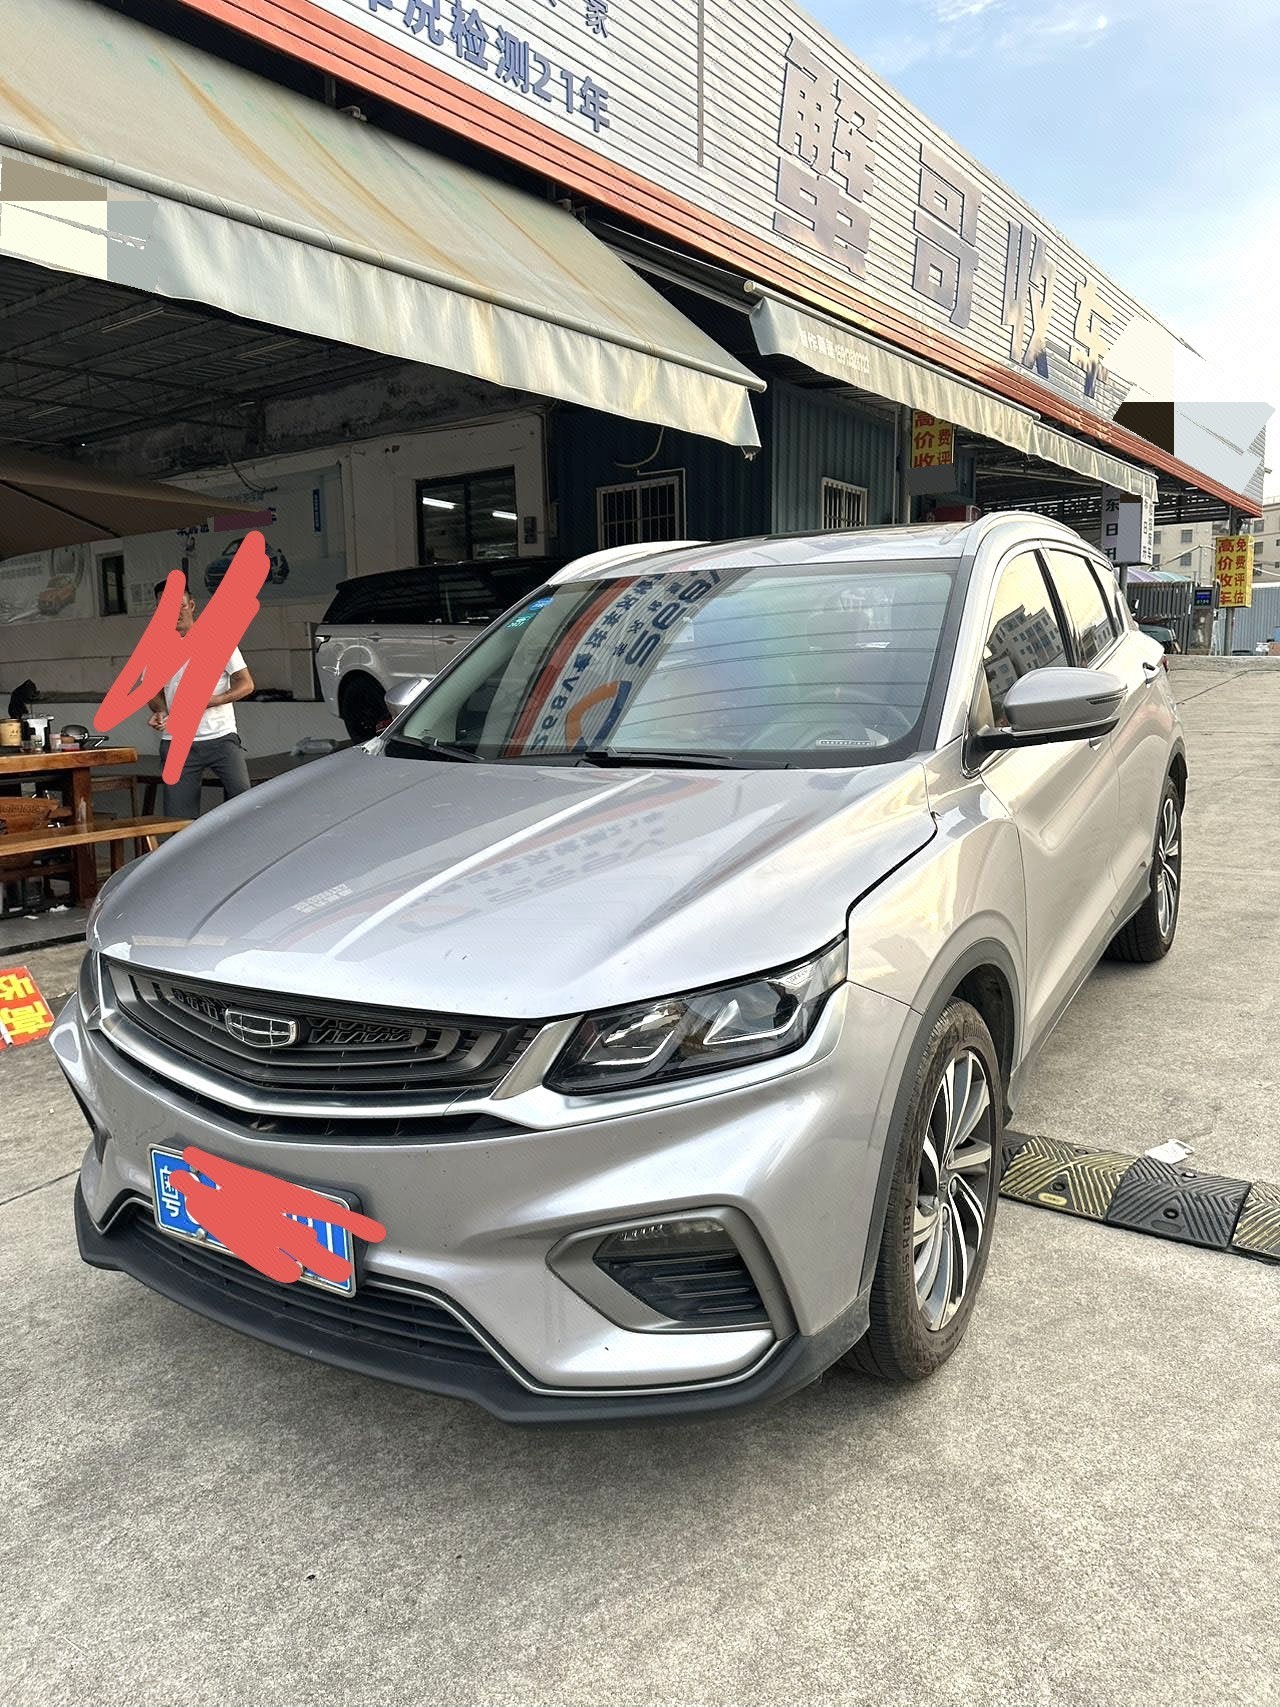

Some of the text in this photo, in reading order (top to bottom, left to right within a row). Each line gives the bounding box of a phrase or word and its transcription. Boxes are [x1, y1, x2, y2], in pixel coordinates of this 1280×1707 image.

[369, 0, 610, 132] 况检测21年
[1218, 539, 1235, 605] 高价收车
[1234, 538, 1247, 604] 免费评估
